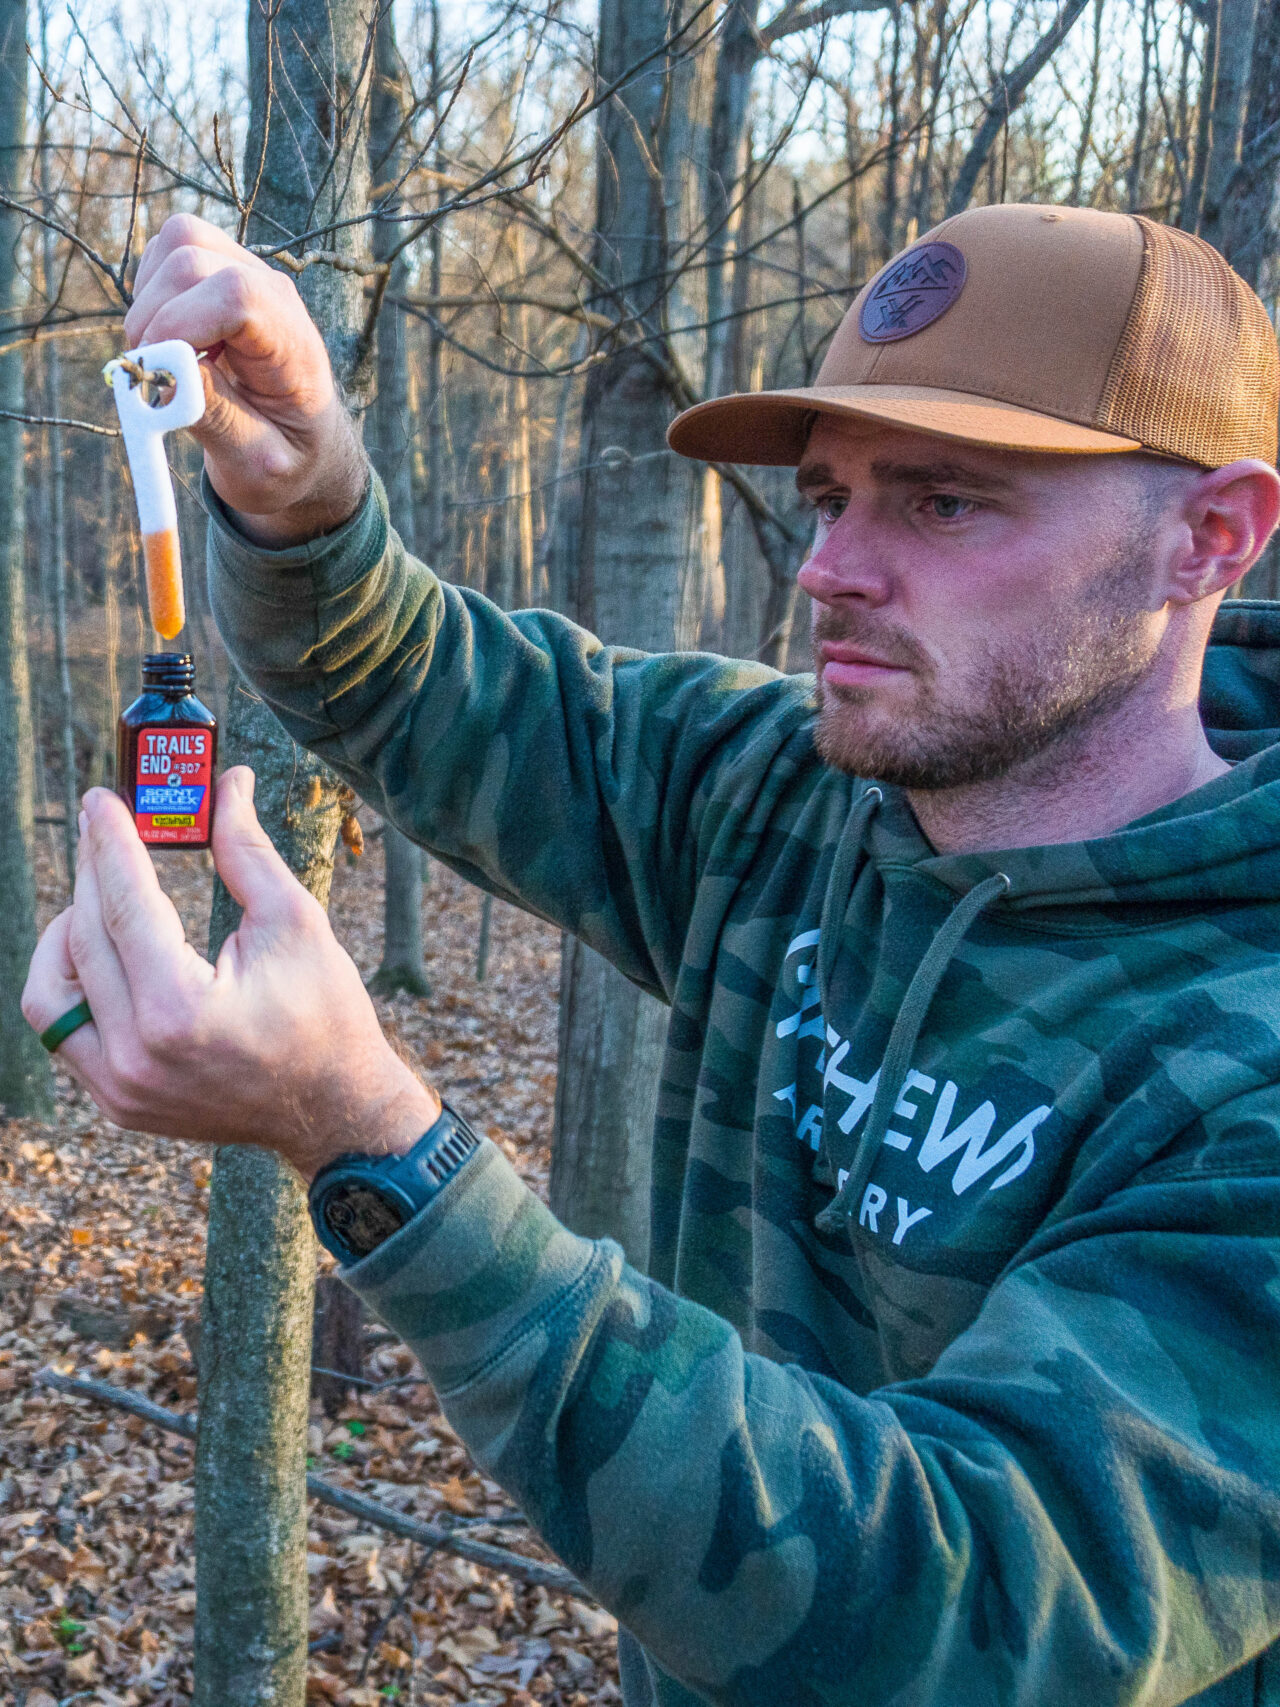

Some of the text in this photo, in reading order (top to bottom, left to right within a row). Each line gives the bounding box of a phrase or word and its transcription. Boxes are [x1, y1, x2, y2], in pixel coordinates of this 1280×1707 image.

[146, 735, 205, 755] TRAIL'S
[140, 754, 171, 774] END
[145, 788, 195, 796] SCENT
[140, 795, 198, 805] REFLEX
